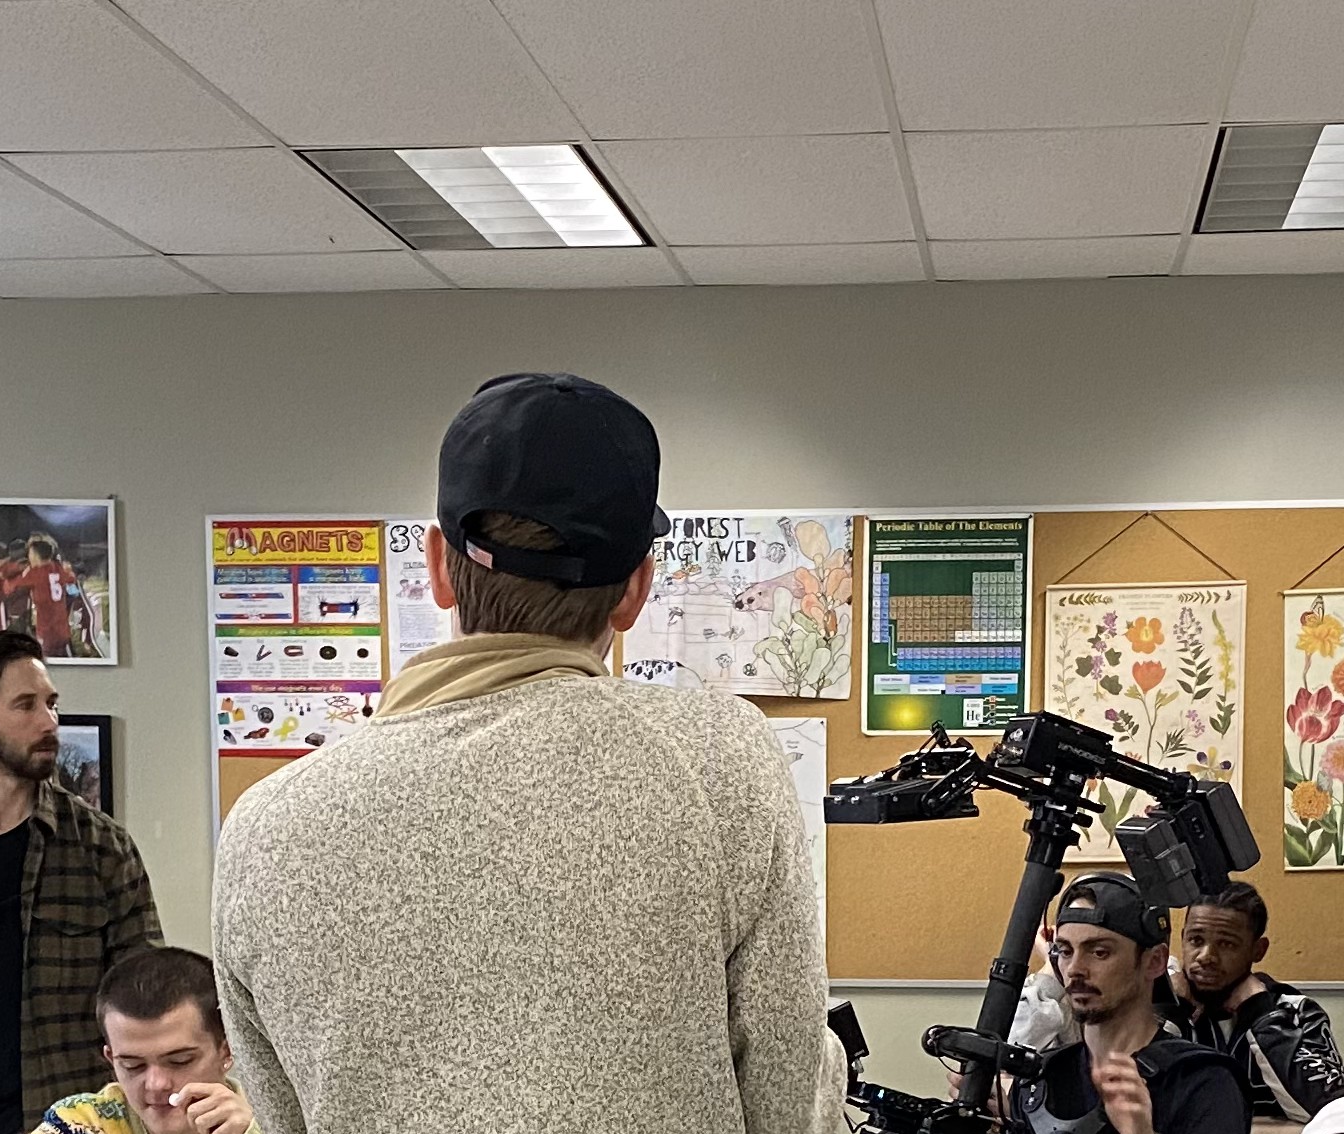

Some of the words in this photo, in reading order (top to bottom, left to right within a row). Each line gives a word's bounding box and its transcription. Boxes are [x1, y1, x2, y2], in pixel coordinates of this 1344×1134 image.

[672, 516, 745, 539] FOREST
[875, 522, 915, 532] Periodic
[917, 521, 944, 531] Table
[946, 521, 956, 531] of
[959, 521, 976, 530] The
[979, 520, 1023, 530] Elements
[225, 526, 364, 556] MAGNETS
[715, 539, 757, 562] WEB
[966, 710, 981, 721] He
